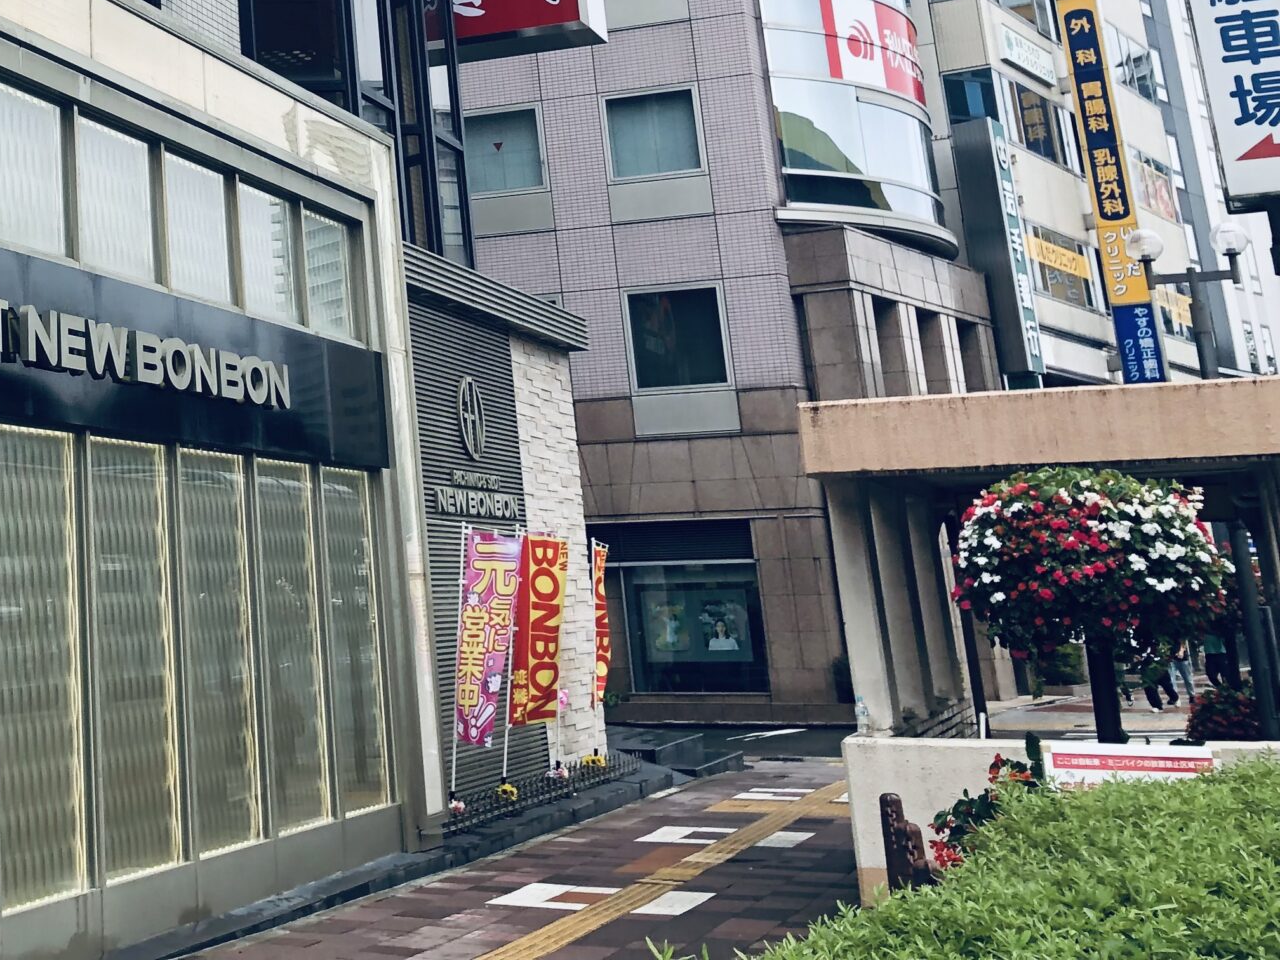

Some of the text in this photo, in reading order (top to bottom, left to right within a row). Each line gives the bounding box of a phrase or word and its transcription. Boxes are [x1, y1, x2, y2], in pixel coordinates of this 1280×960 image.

[1070, 16, 1097, 67] 外科
[1080, 81, 1110, 134] 胃腸科
[1103, 231, 1128, 296] クリニック
[1120, 226, 1142, 278] いだ
[24, 304, 128, 379] NEW
[136, 330, 291, 410] BONBON
[1123, 338, 1141, 382] クリニック
[436, 489, 519, 519] NEW BONBON
[558, 540, 569, 572] NEW
[471, 542, 518, 653] 元気に
[526, 540, 561, 721] BONBON
